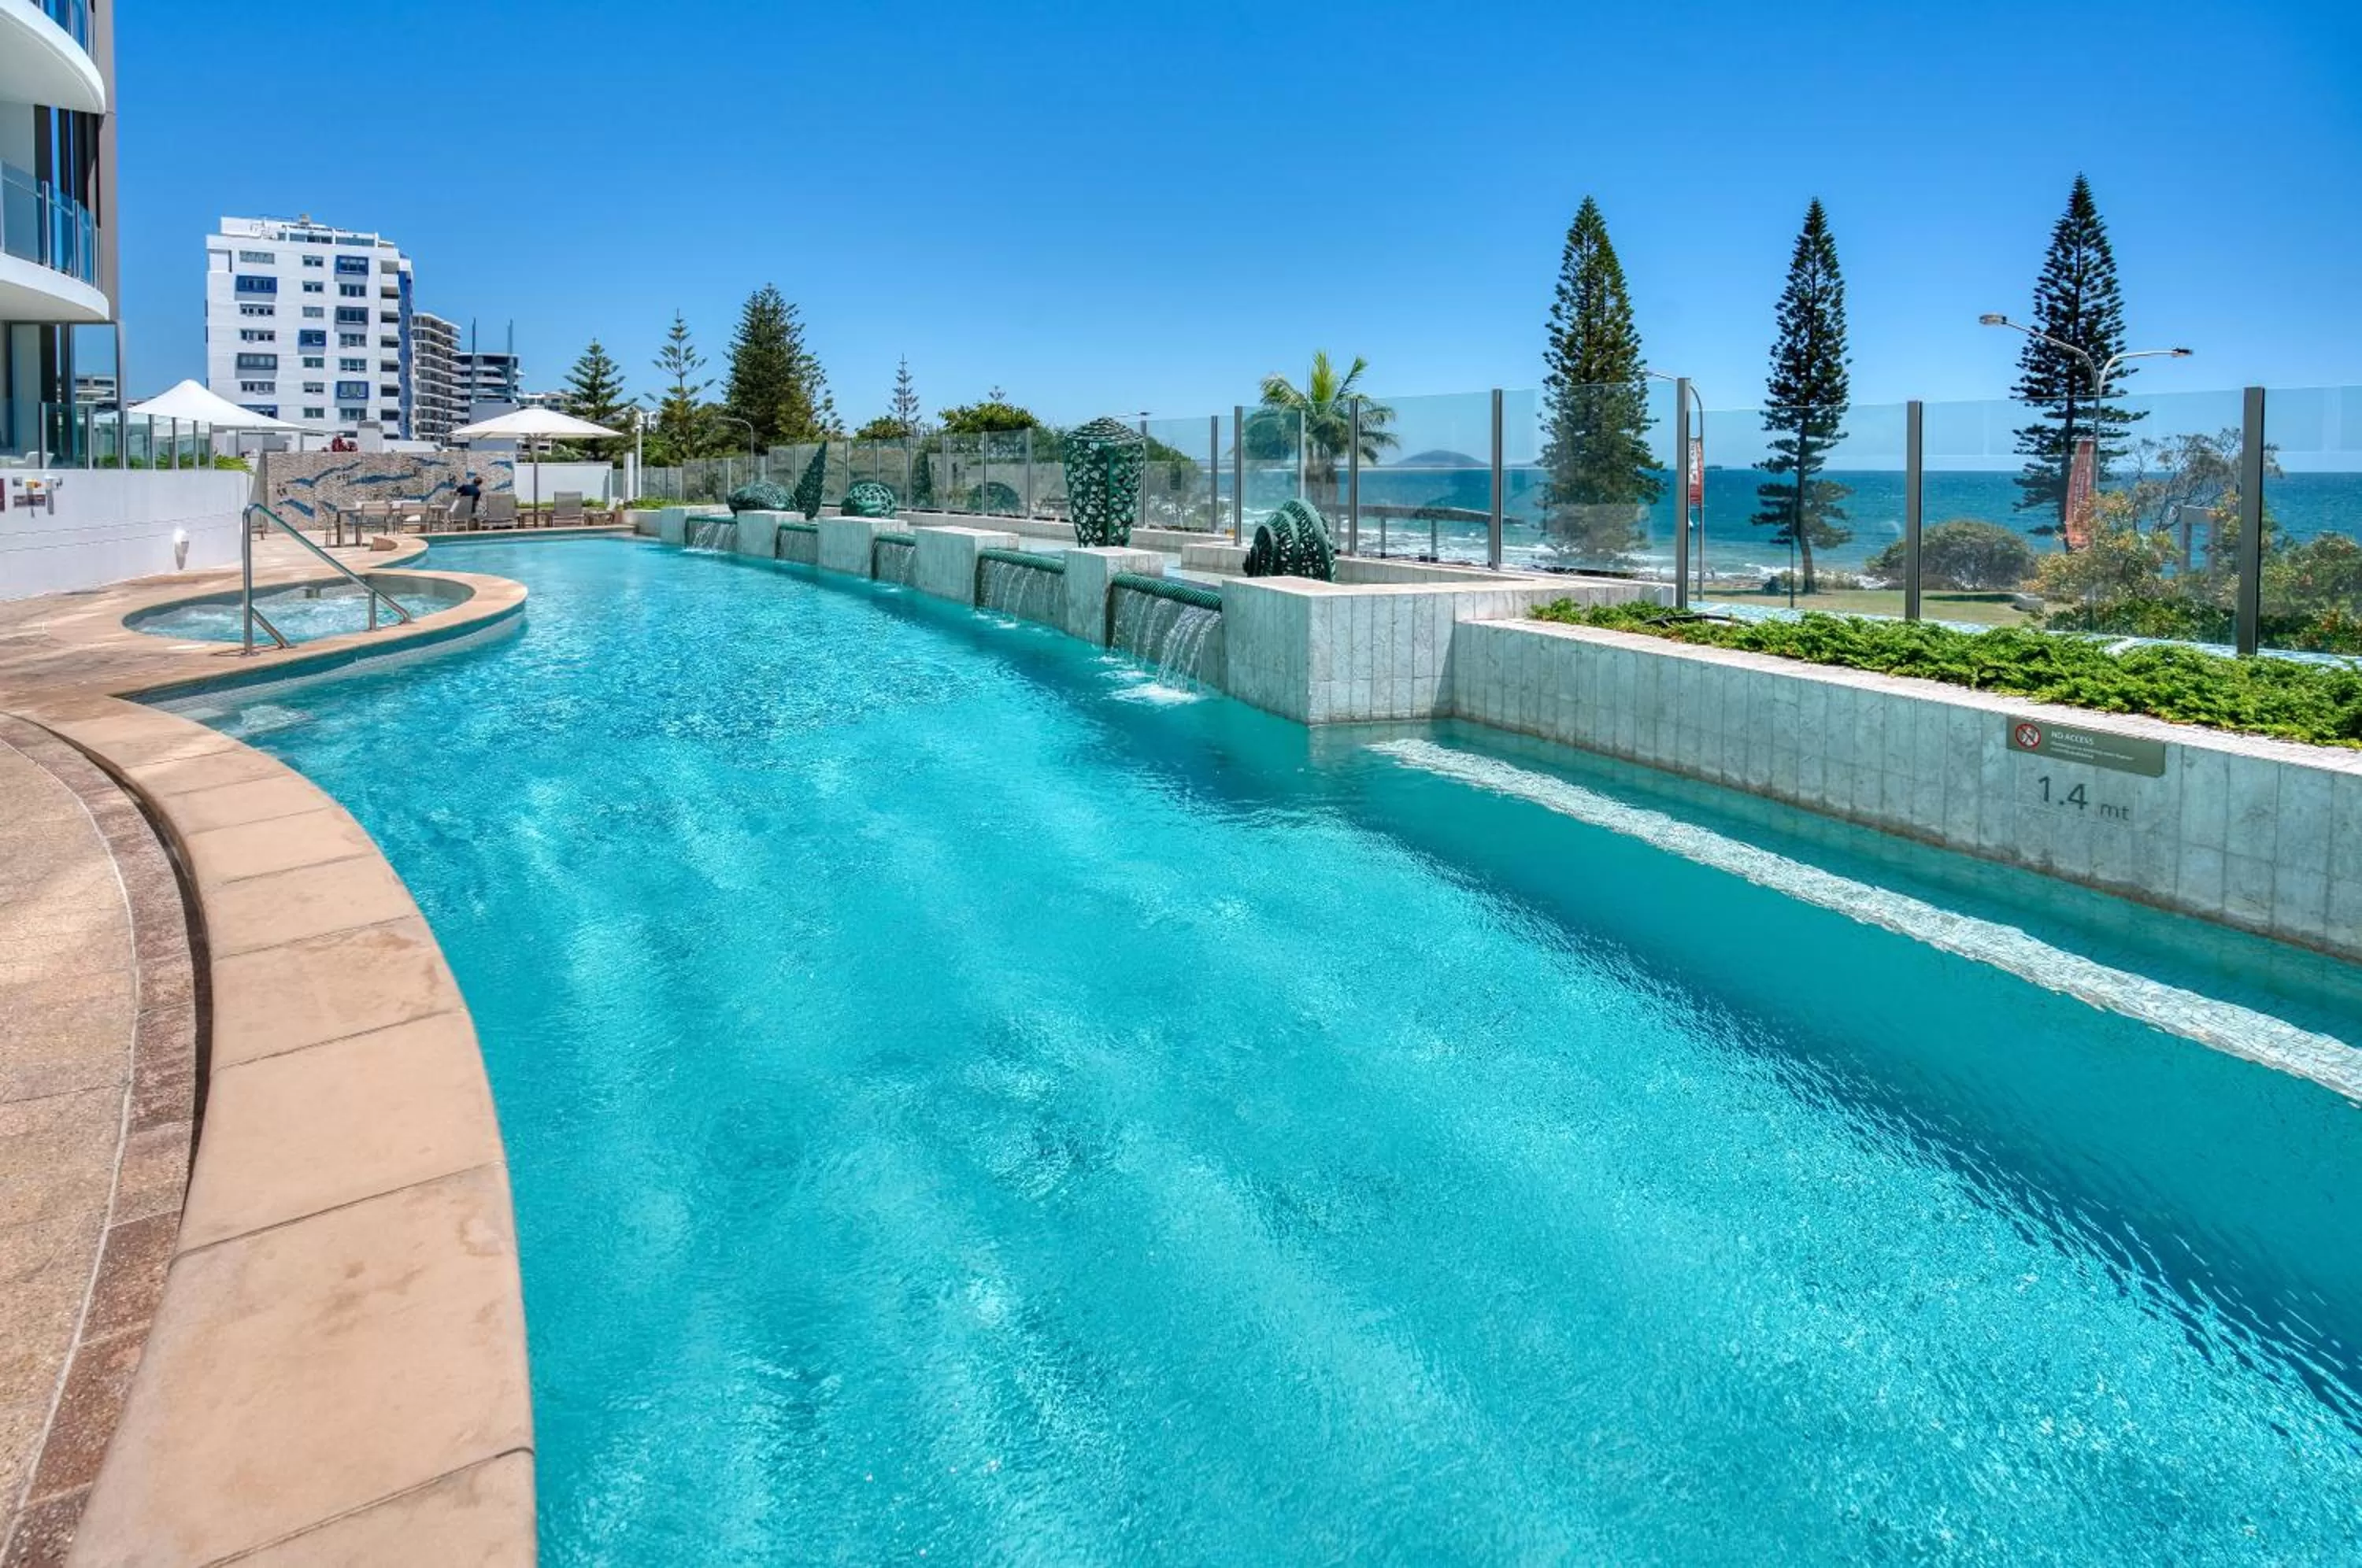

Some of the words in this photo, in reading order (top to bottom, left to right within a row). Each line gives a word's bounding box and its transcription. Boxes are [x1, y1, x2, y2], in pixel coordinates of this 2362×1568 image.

[2051, 730, 2064, 739] NO
[2064, 733, 2094, 745] ACCESS
[2038, 775, 2088, 810] 1.4
[2100, 803, 2130, 820] mt
